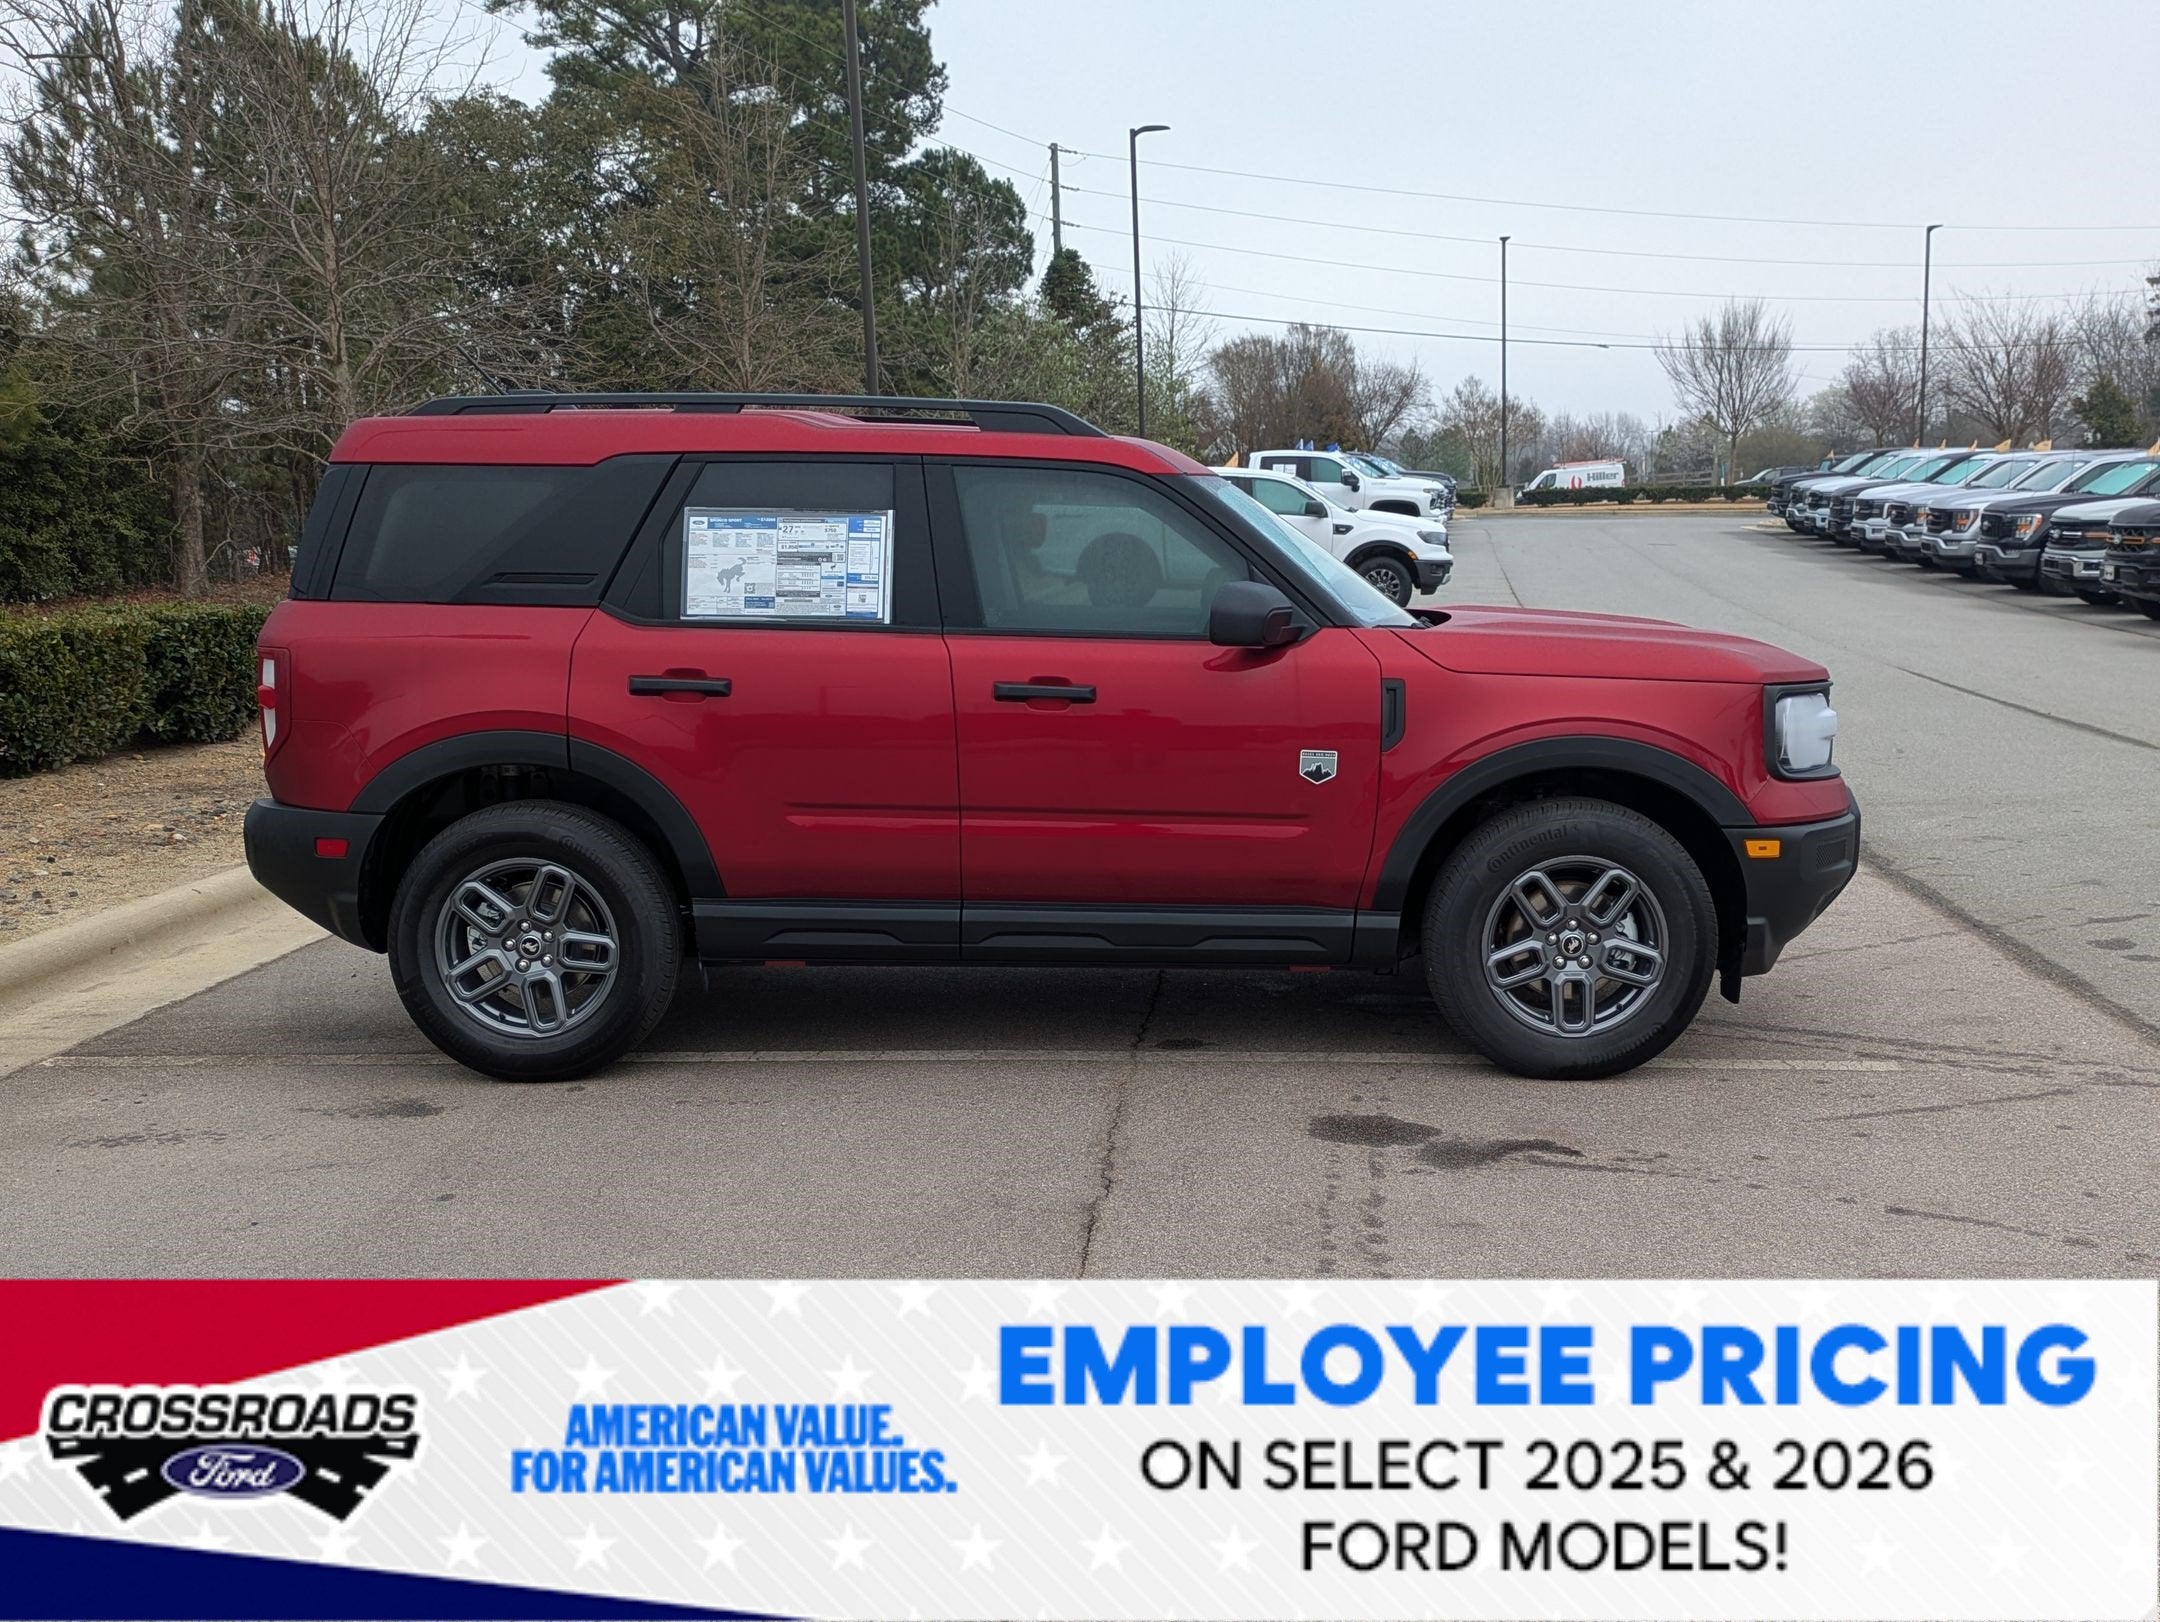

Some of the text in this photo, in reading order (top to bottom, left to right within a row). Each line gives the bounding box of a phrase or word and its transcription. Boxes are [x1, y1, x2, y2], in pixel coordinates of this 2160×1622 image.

[1586, 471, 1619, 482] Hiller
[782, 525, 794, 534] 27
[1486, 823, 1569, 874] Continental
